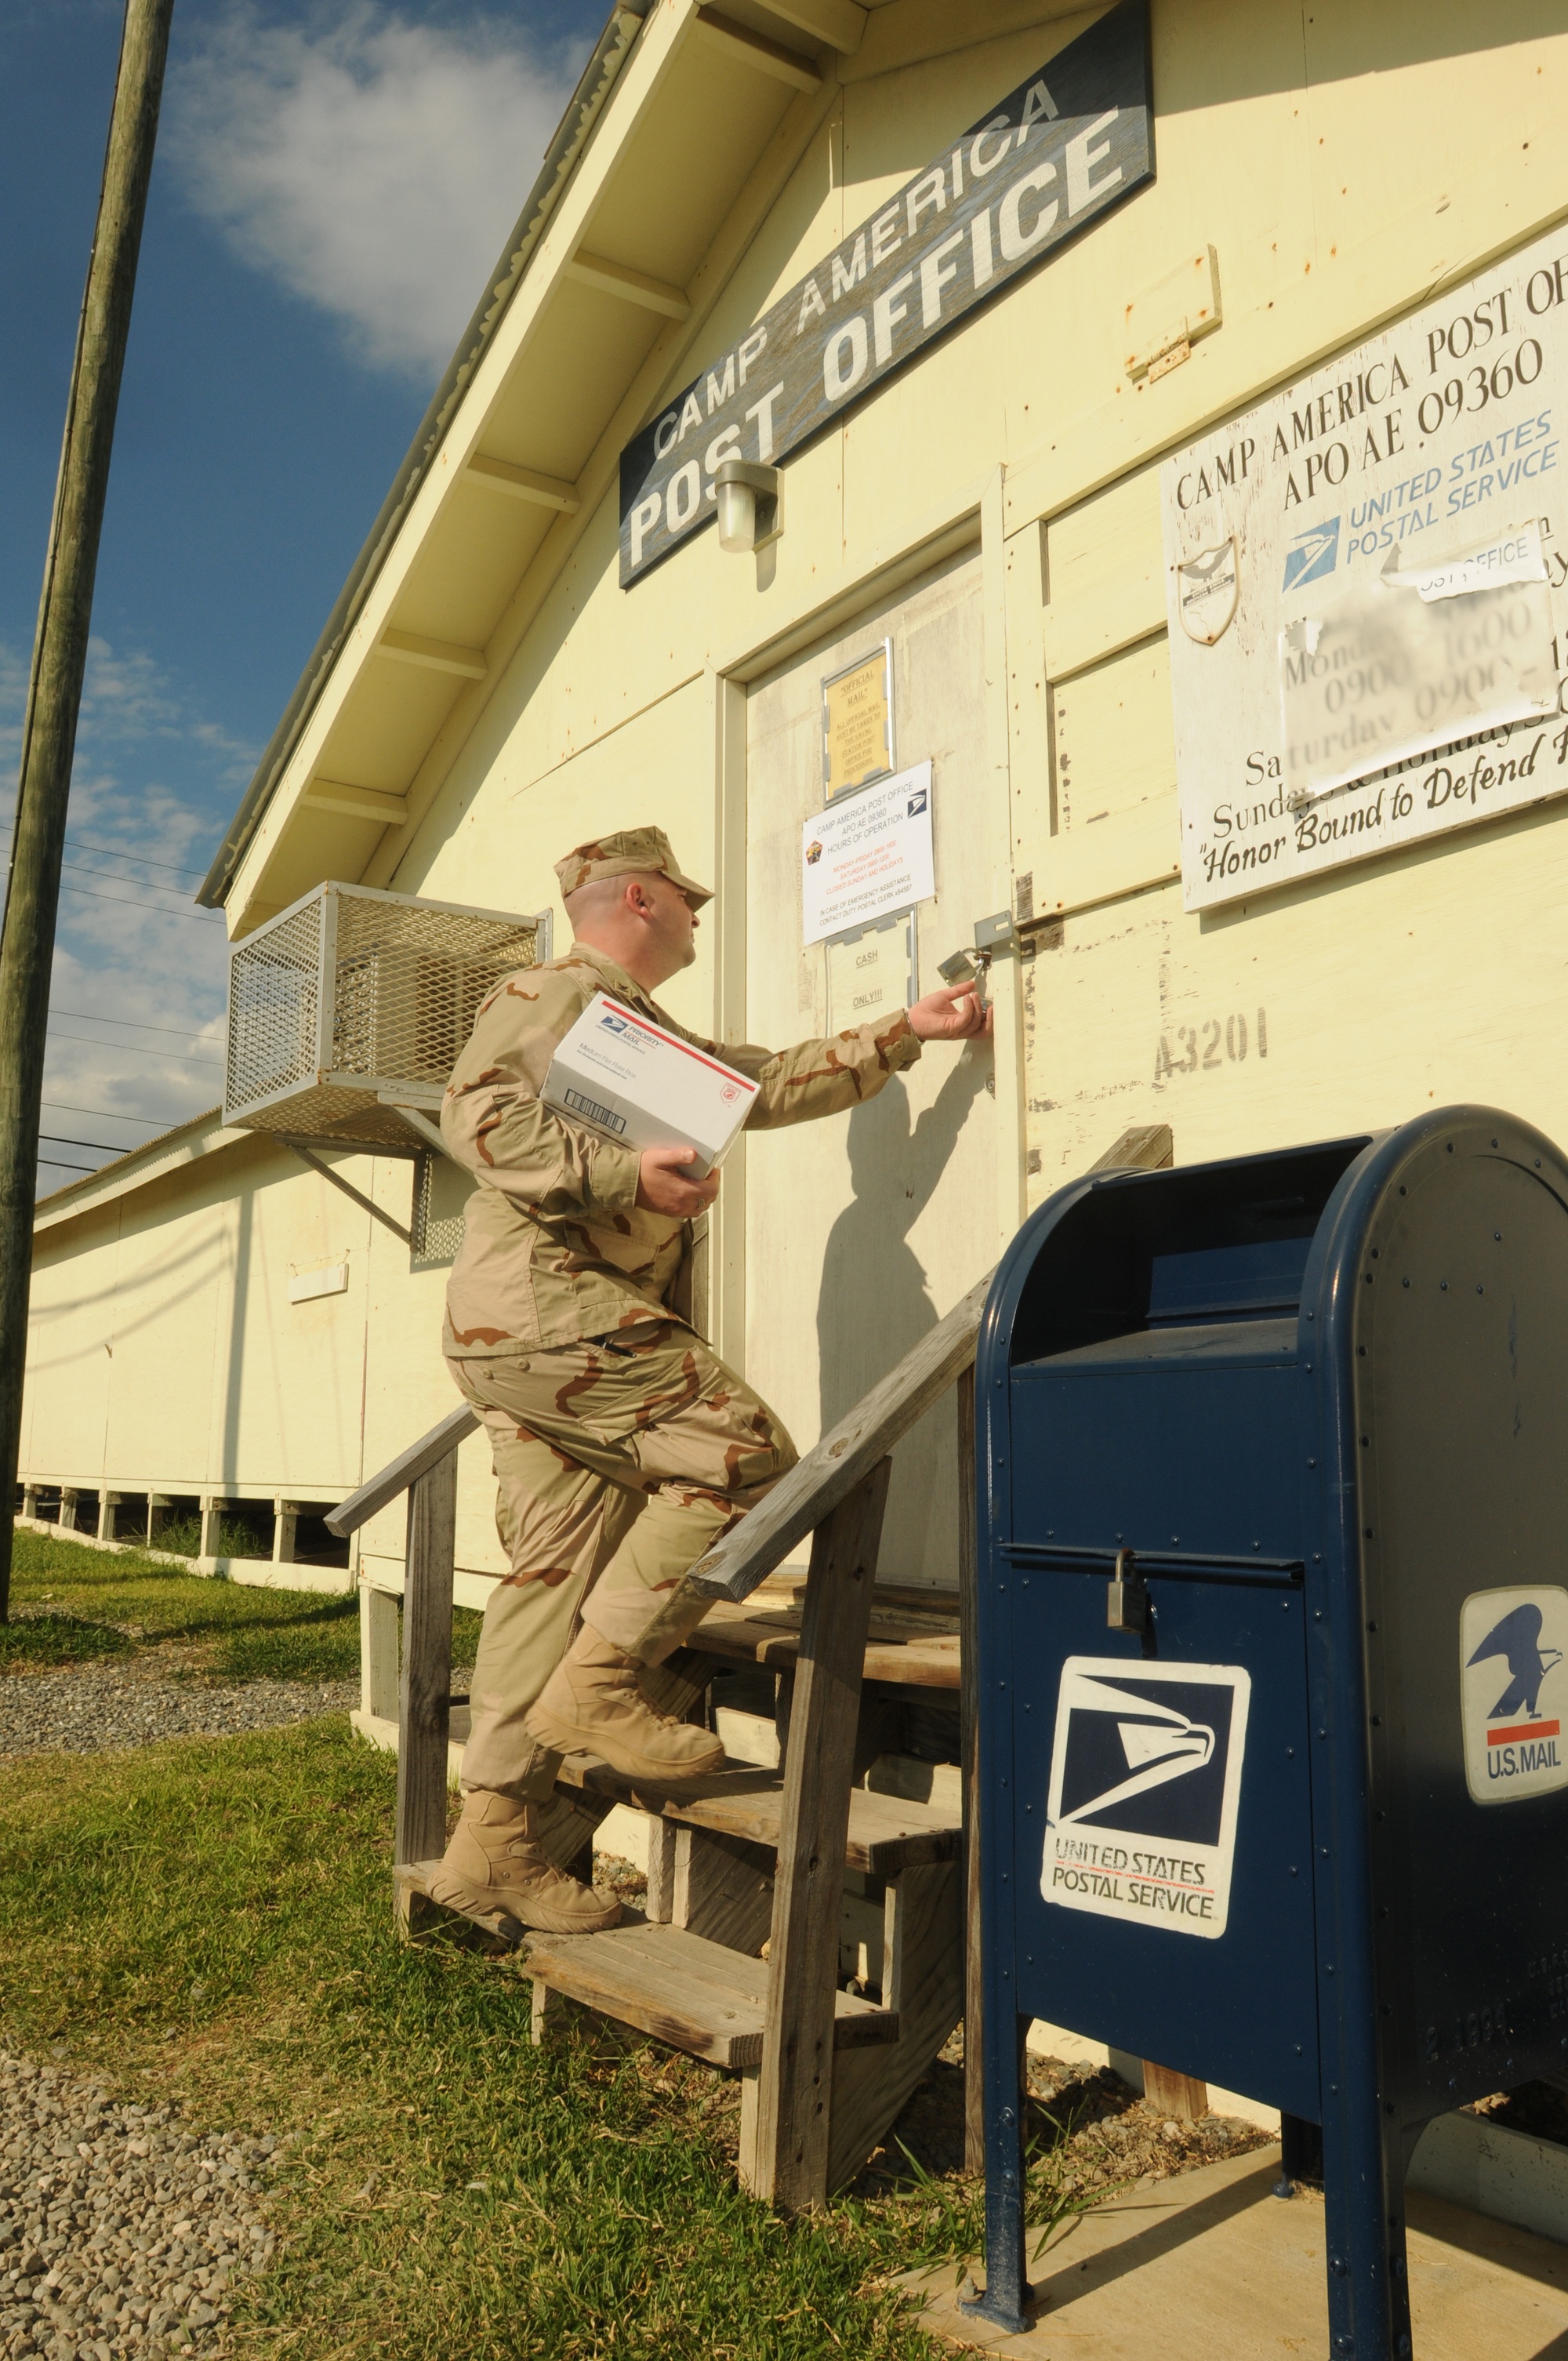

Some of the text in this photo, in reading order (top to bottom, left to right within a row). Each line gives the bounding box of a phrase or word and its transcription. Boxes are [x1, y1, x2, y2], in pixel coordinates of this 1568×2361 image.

[654, 80, 1059, 459] CAMP AMERICA
[630, 107, 1123, 568] POST OFFICE
[1177, 438, 1255, 510] CAMP
[1272, 353, 1410, 462] AMERICA
[1425, 287, 1512, 376] POST
[1283, 442, 1349, 511] APO
[1418, 339, 1543, 434] 09360
[1350, 409, 1552, 529] UNITED STATES
[1346, 441, 1560, 565] POSTAL SERVICE
[816, 781, 913, 835] CAMP AMERICA POST OFFICE
[1295, 788, 1385, 853] Bound
[1391, 783, 1412, 821] to
[1423, 733, 1547, 810] Defend
[827, 812, 903, 855] HOURS OF OPERATION
[841, 808, 887, 836] APO AE 09360
[826, 856, 904, 895] CLOSED SUNDAY AND HOLIDAYS
[840, 865, 866, 880] SATURDAY
[848, 887, 879, 906] EMERGENCY
[880, 874, 912, 892] ASSISTANCE
[857, 898, 877, 913] POSTAL
[878, 891, 895, 903] CLERK
[856, 950, 878, 968] CASH
[853, 989, 883, 1008] ONLY!!!
[579, 1042, 637, 1079] Medium Flat Rate Box
[622, 1032, 640, 1046] MAIL
[1154, 1006, 1268, 1081] A3201
[1055, 1837, 1205, 1886] UNITED STATES
[1052, 1866, 1214, 1920] POSTAL SERVICE
